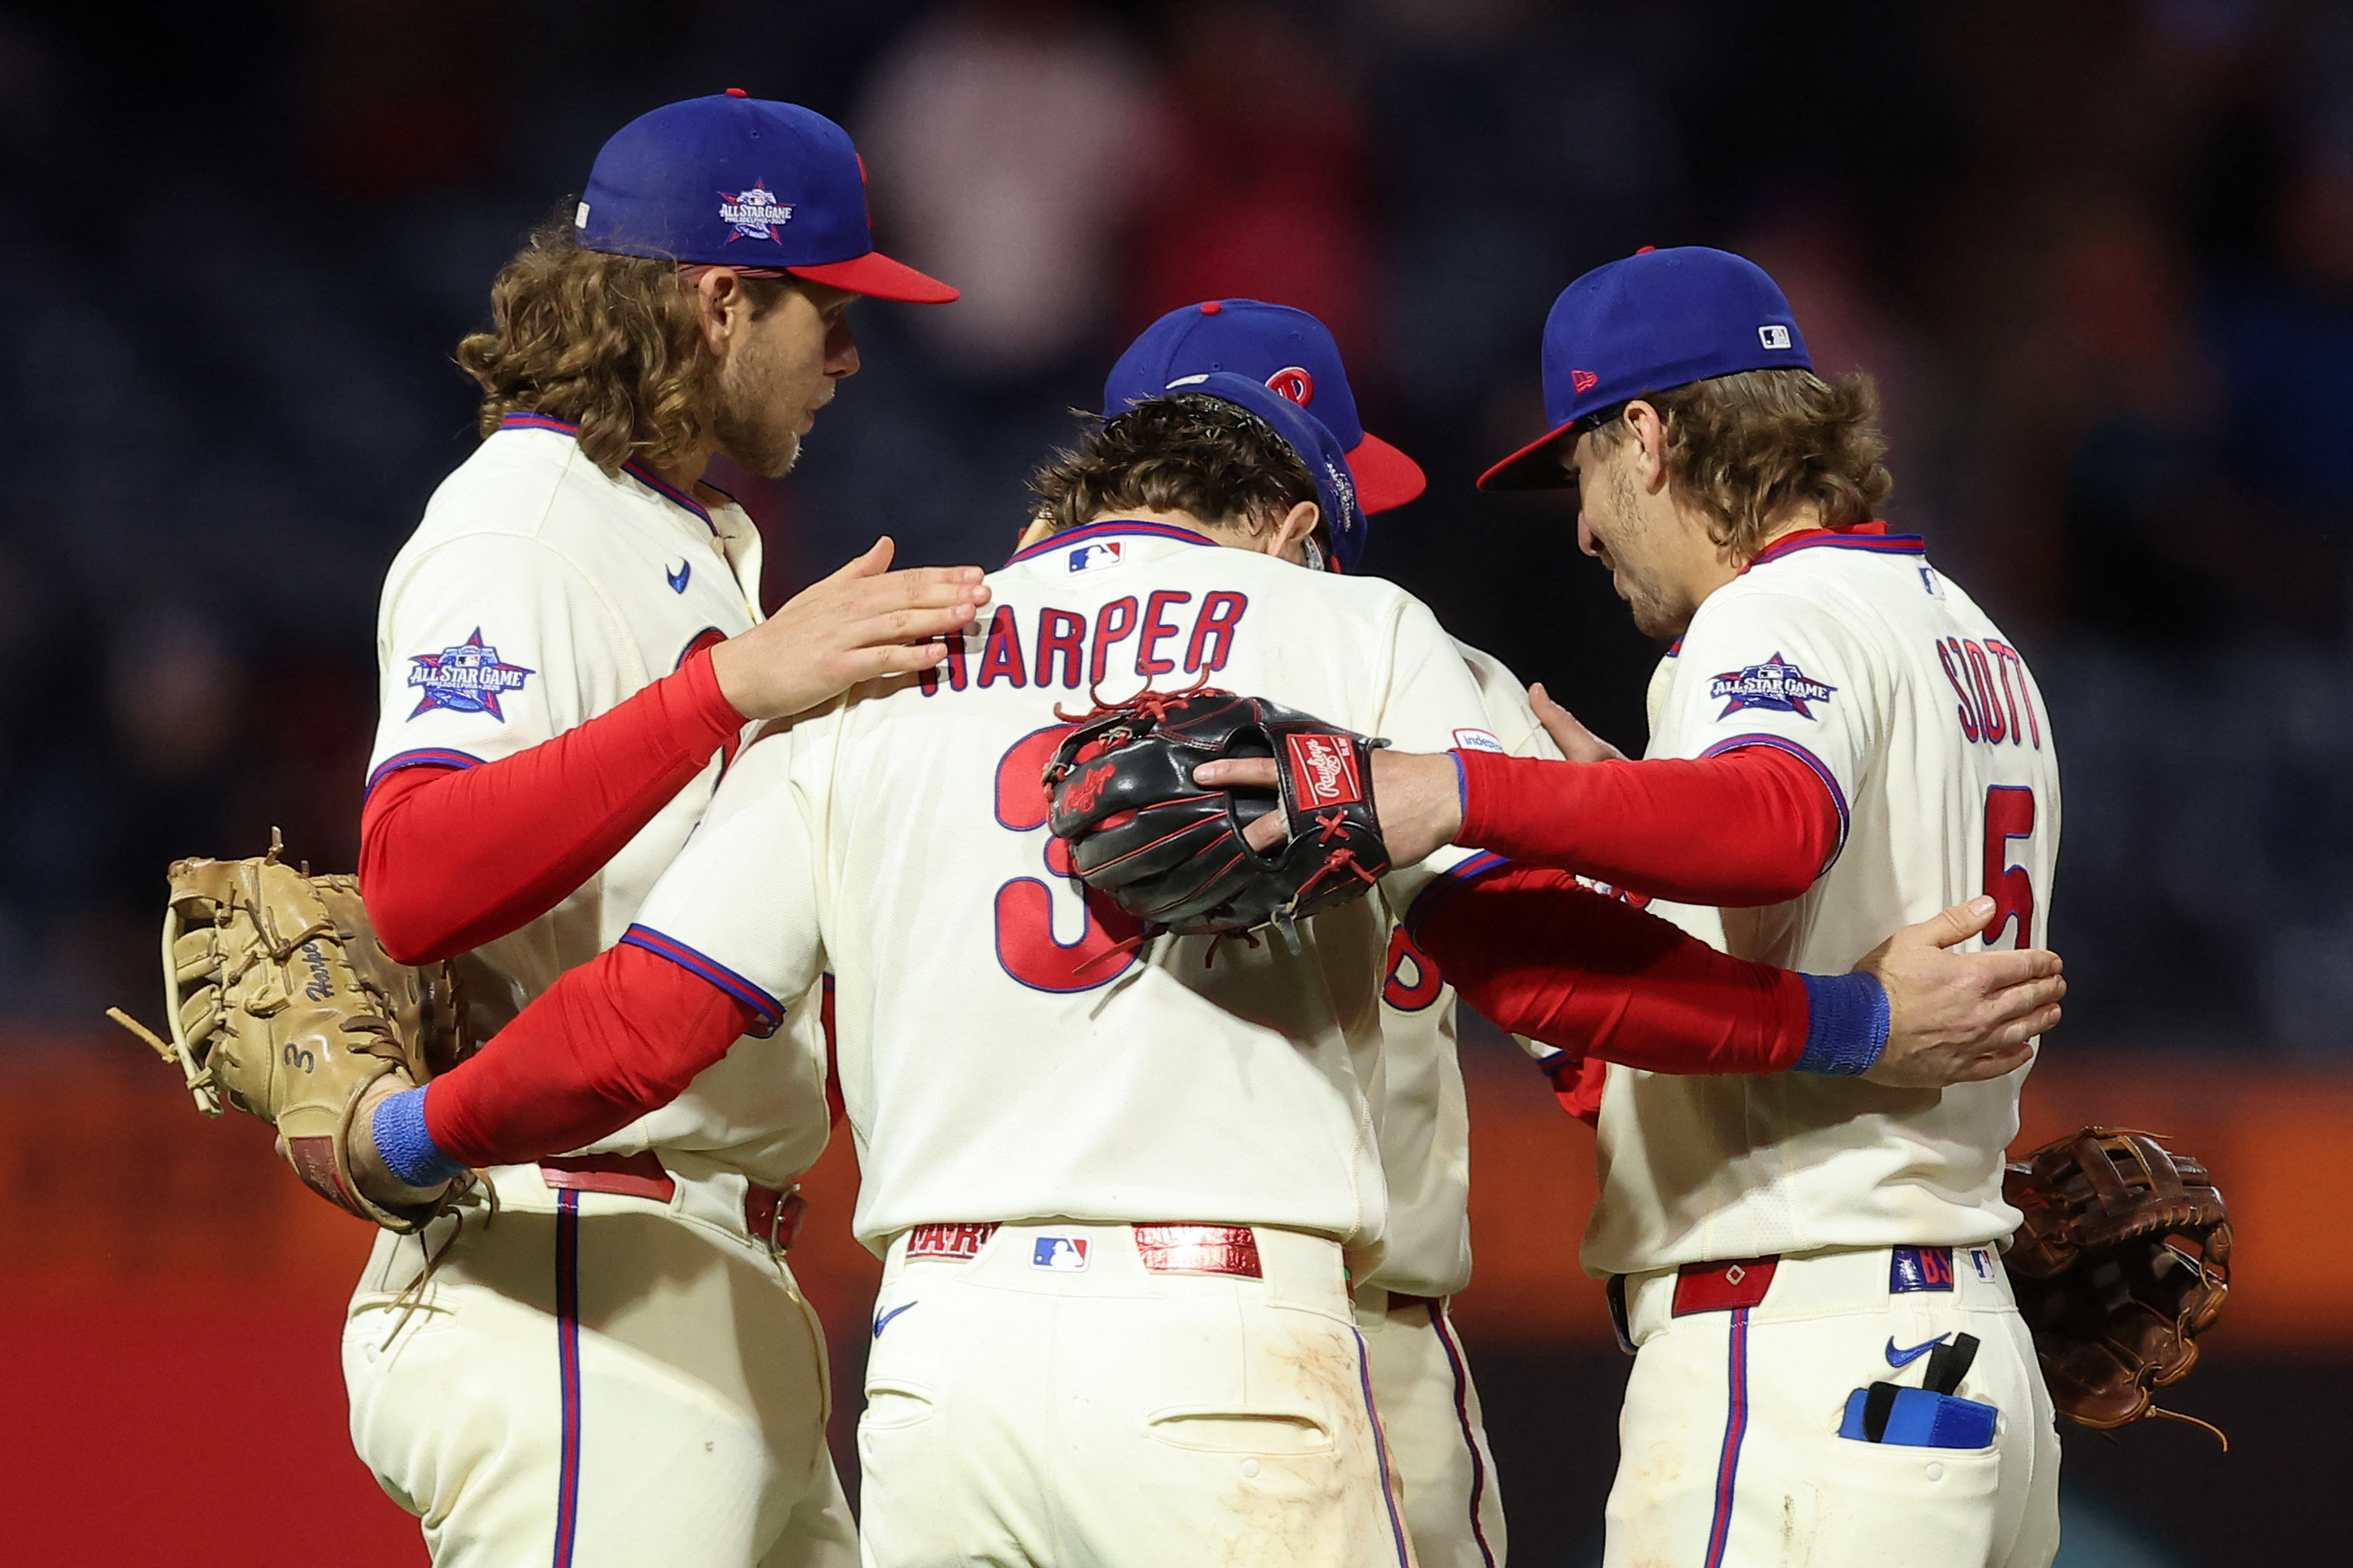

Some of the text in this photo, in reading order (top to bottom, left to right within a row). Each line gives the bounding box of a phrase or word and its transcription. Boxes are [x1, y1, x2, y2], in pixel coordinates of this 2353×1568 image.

[765, 206, 792, 219] GAME
[410, 665, 523, 687] ALL STAR GAME
[1713, 679, 1744, 696] ALL
[1744, 677, 1783, 693] STAR
[1784, 678, 1827, 699] GAME
[1306, 738, 1342, 798] Rawlings
[996, 723, 1144, 994] 3
[1983, 784, 2034, 949] 5
[284, 1043, 315, 1074] 3
